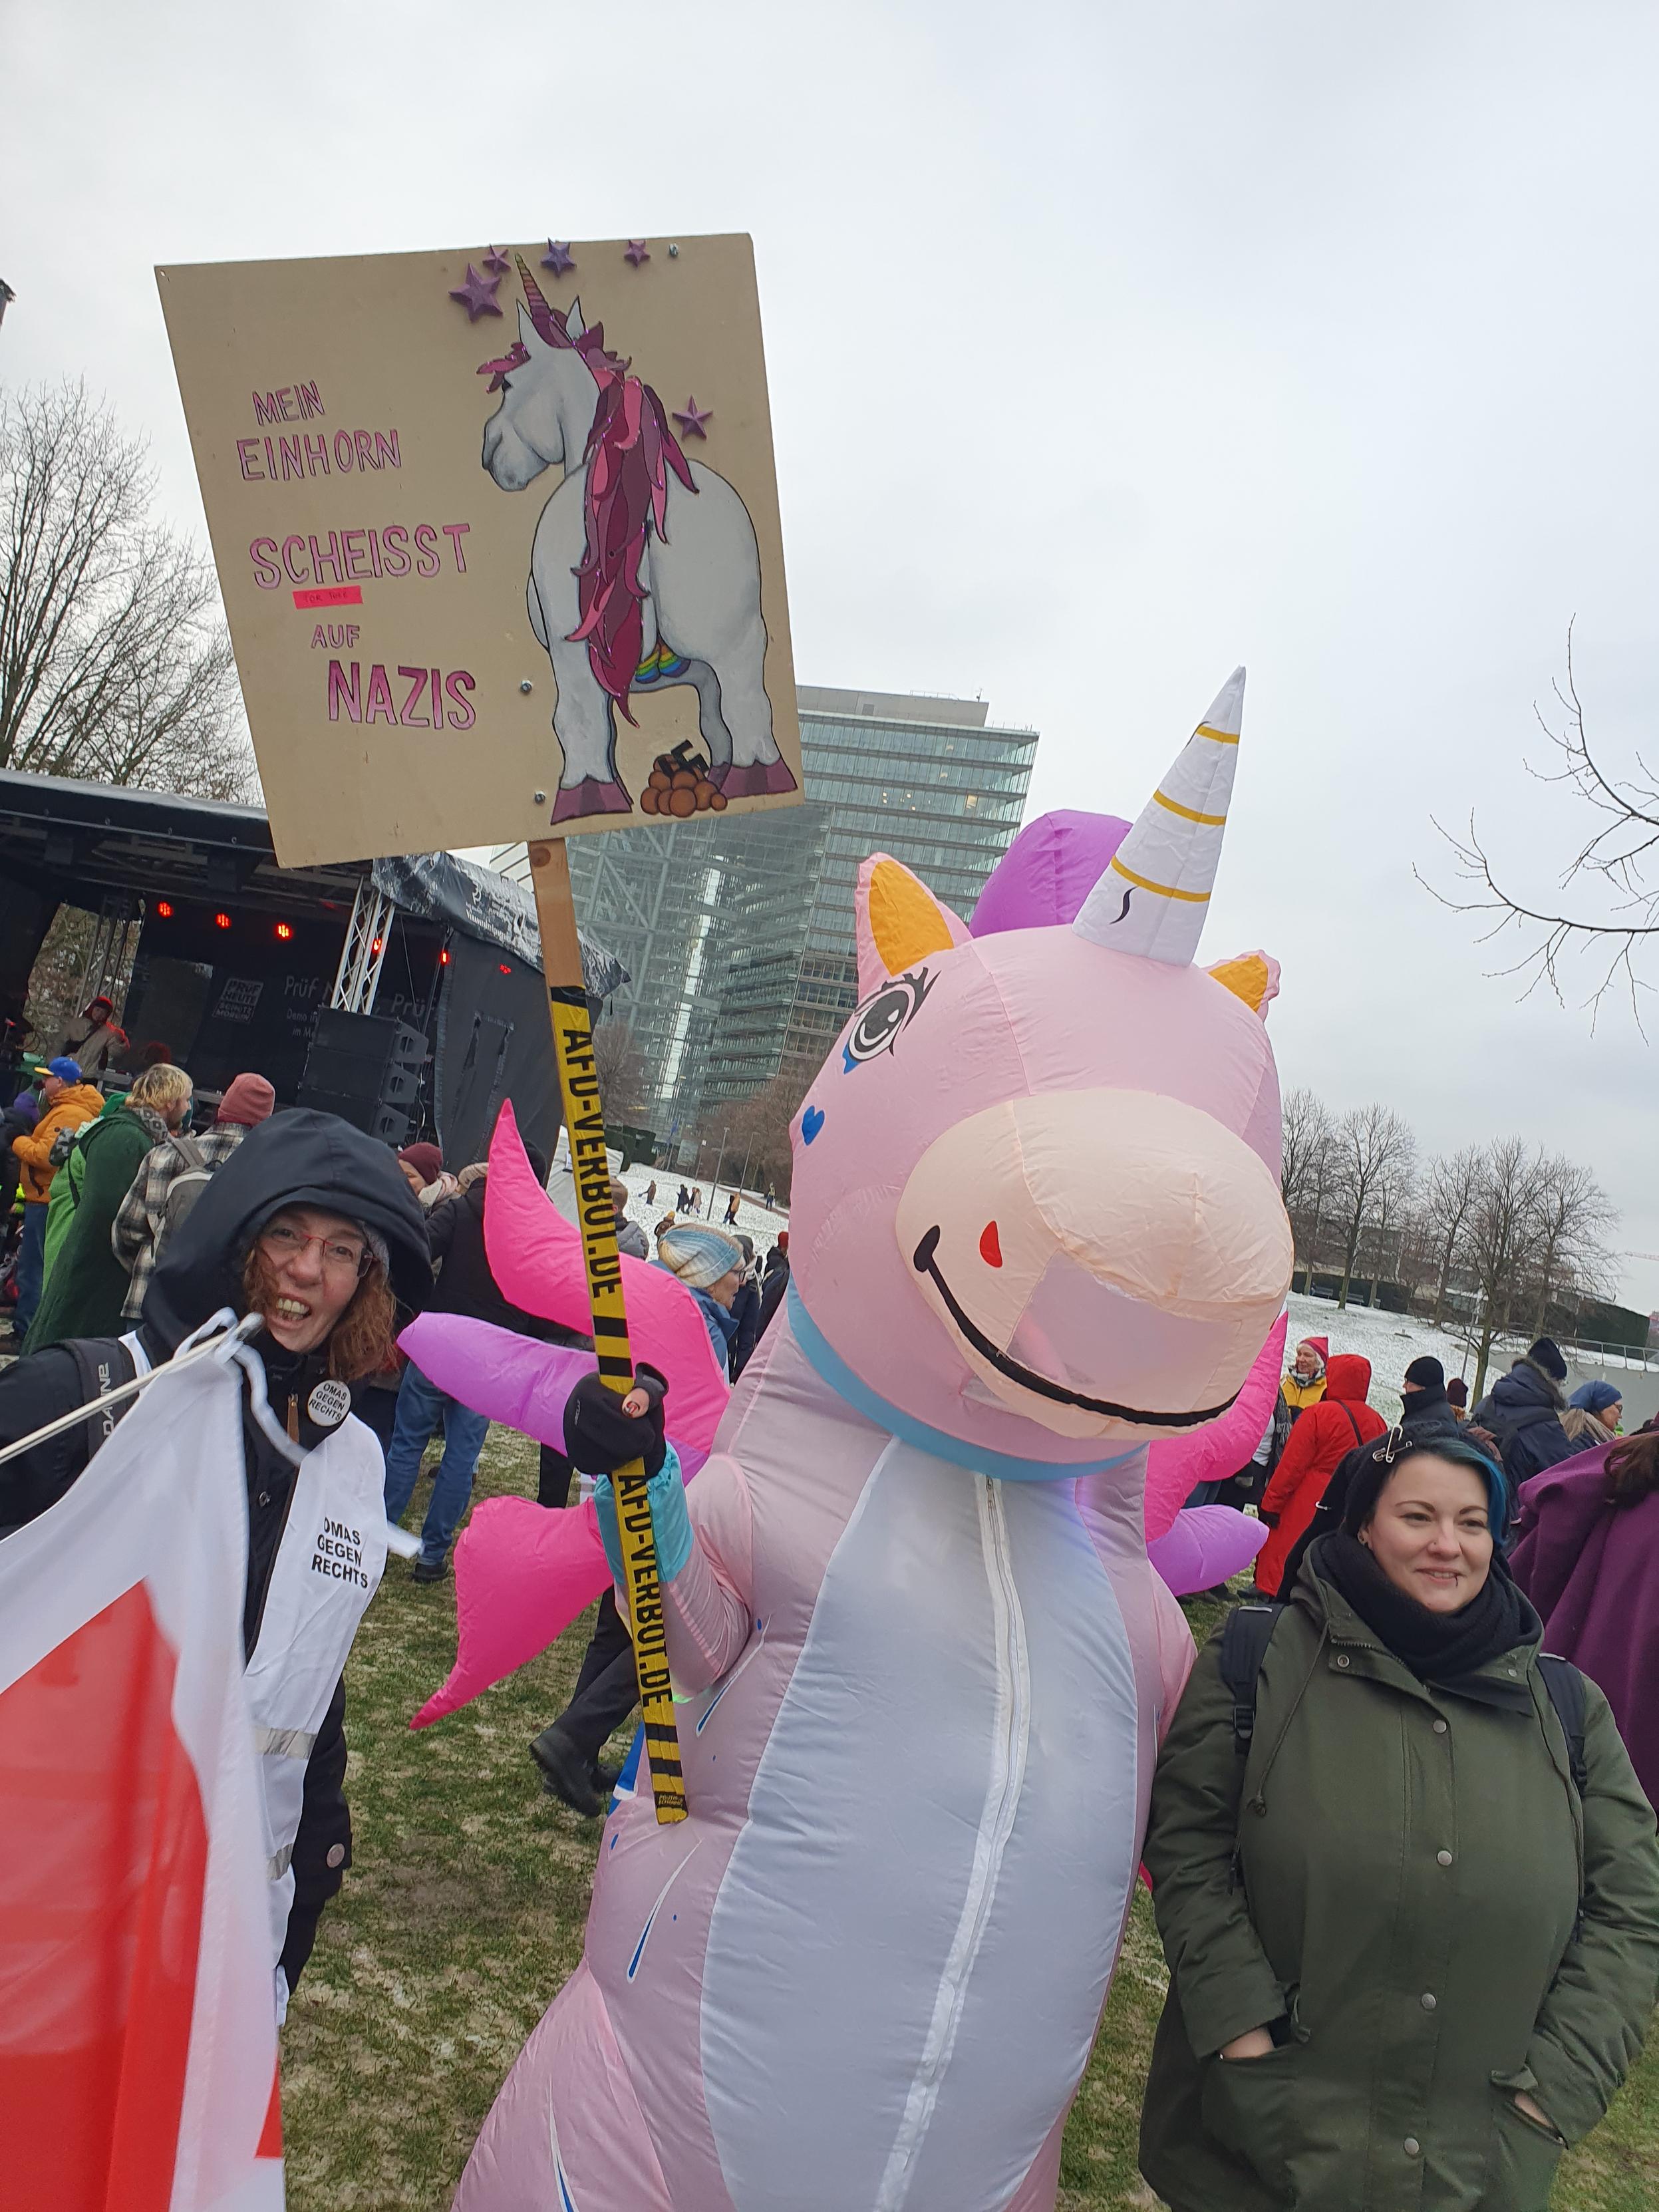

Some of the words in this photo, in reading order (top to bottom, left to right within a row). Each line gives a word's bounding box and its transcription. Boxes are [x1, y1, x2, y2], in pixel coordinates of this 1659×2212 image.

[251, 380, 325, 426] MEIN
[236, 428, 402, 482] EINHORN
[249, 523, 470, 589] SCHEISST
[310, 624, 361, 649] AUF
[328, 659, 476, 730] NAZIS
[284, 975, 319, 999] Prüf
[390, 993, 434, 1017] Prü
[563, 1028, 623, 1299] AFD-VERBOT.DE
[98, 1362, 114, 1436] DANE
[316, 1390, 345, 1412] GEGEN
[323, 1382, 347, 1401] OMAS
[309, 1398, 342, 1421] RECHTS
[324, 1516, 361, 1546] OMAS
[317, 1533, 363, 1568] GEGEN
[311, 1553, 369, 1589] RECHTS
[617, 1474, 674, 1708] AFD-VERBOT.DE
